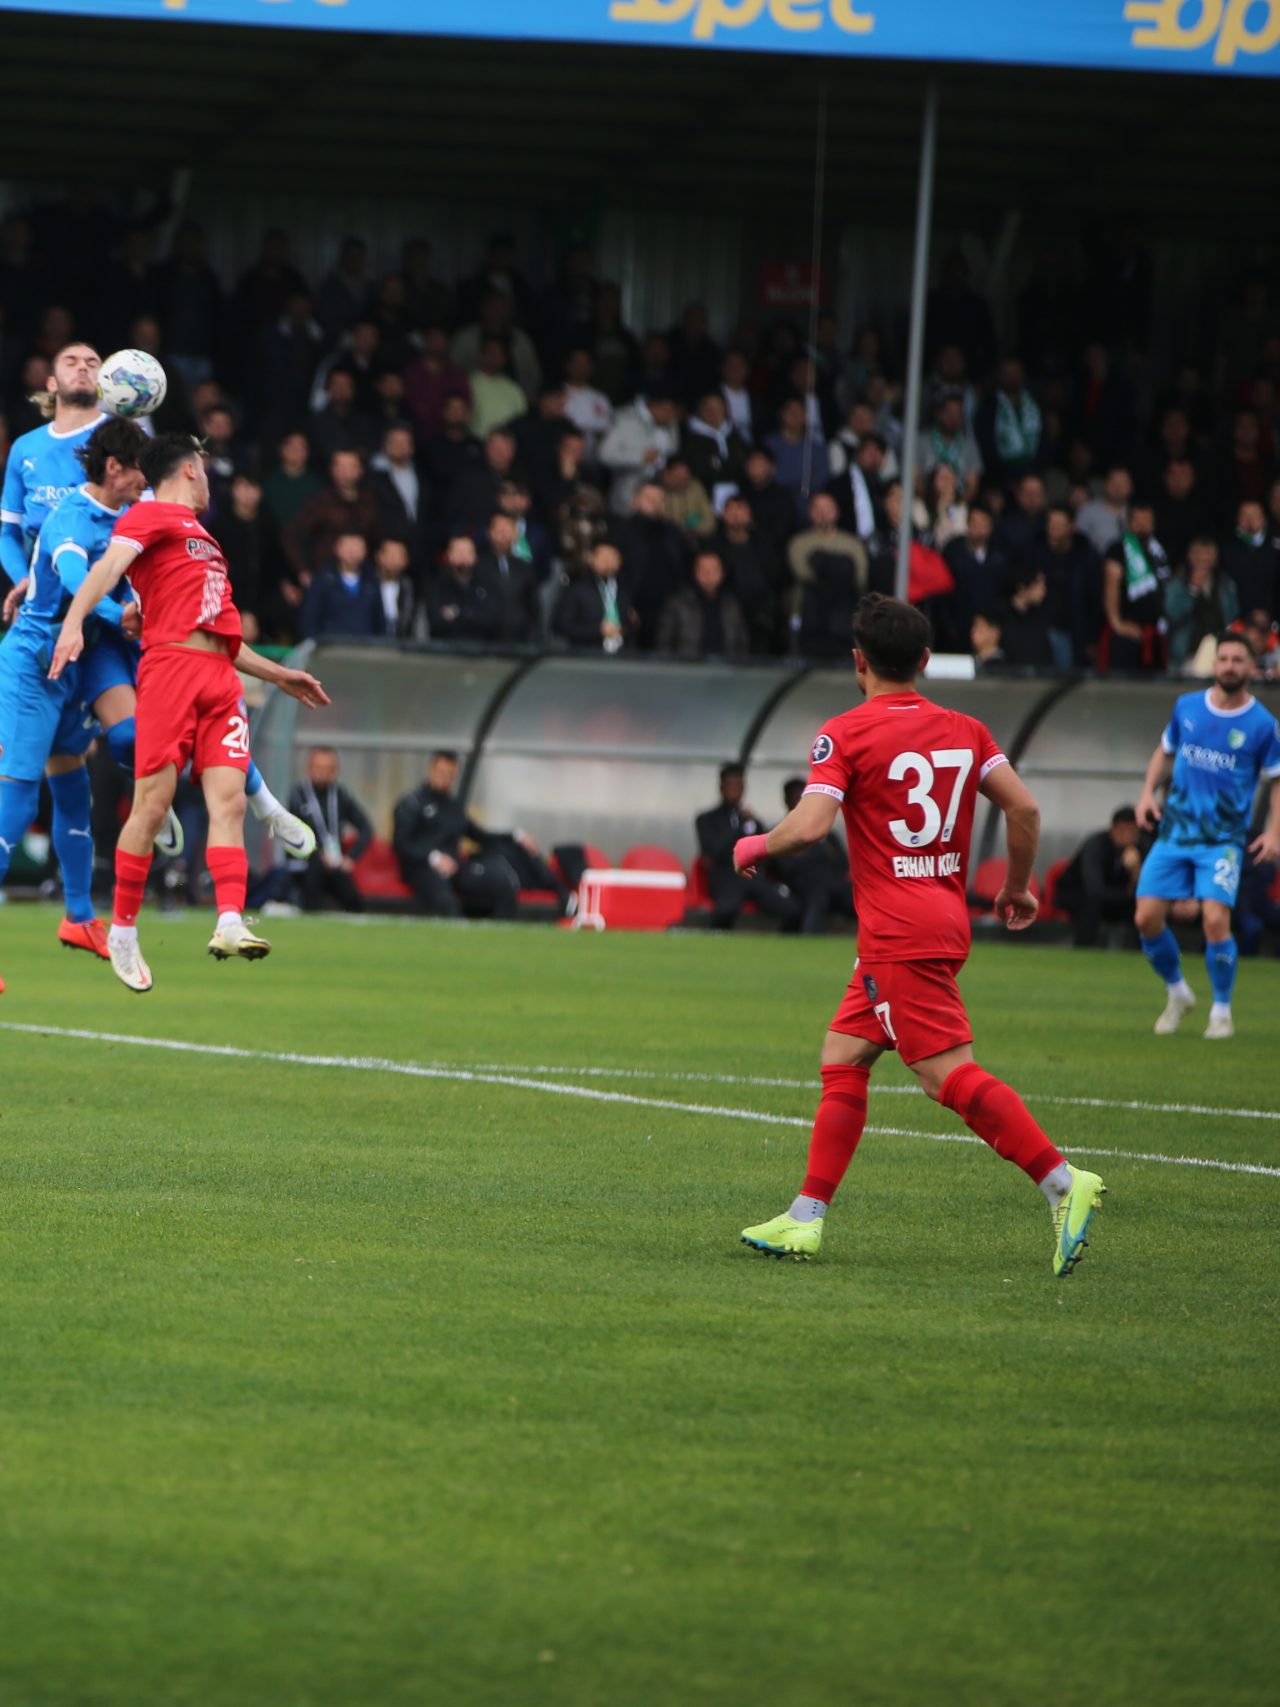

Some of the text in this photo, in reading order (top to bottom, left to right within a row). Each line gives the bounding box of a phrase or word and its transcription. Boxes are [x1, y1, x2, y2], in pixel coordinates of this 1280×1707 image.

[221, 715, 250, 753] 20
[888, 749, 974, 848] 37
[892, 855, 935, 878] ERHAN
[874, 1001, 897, 1040] 7
